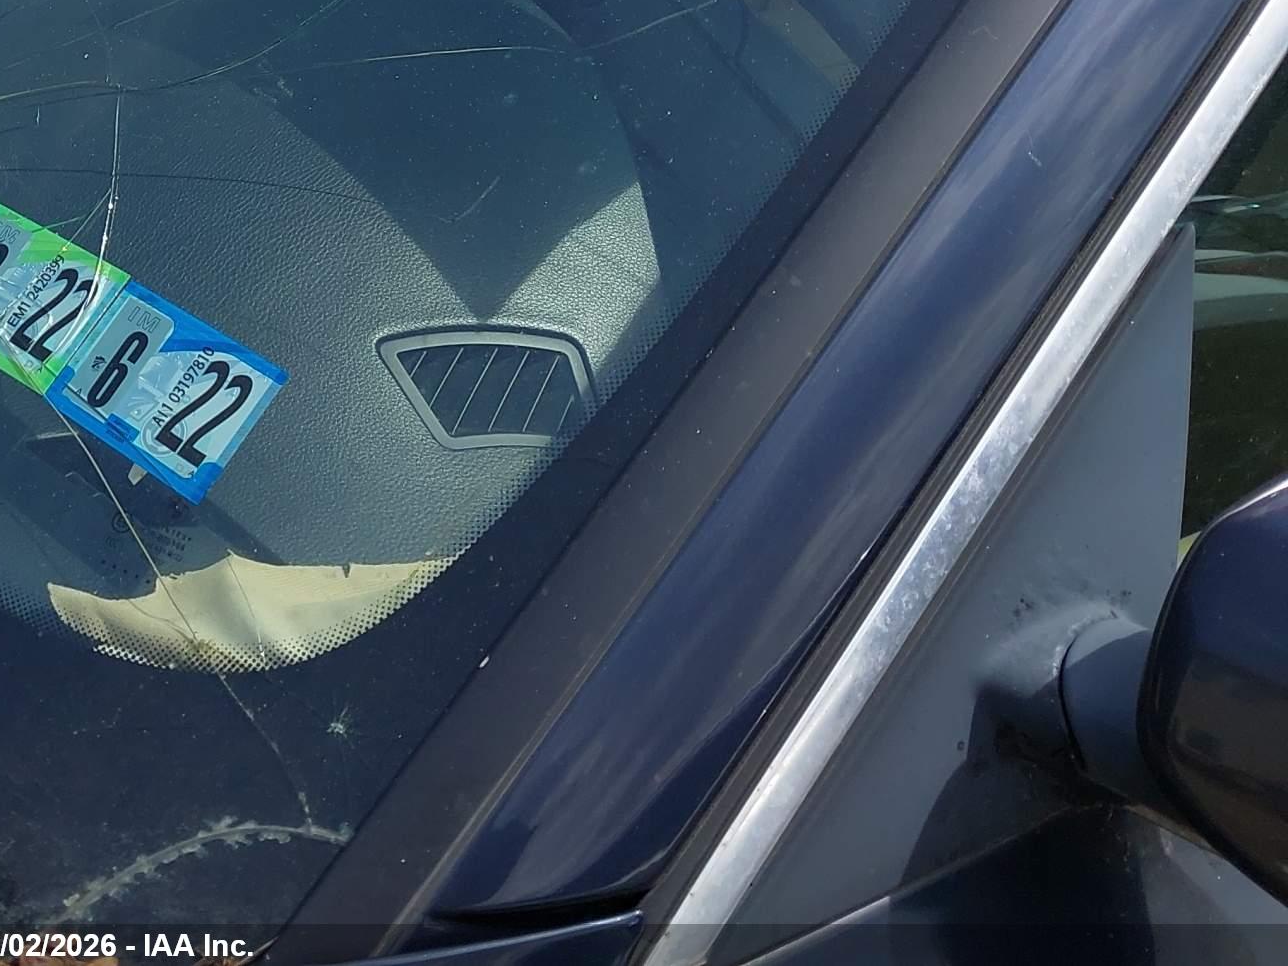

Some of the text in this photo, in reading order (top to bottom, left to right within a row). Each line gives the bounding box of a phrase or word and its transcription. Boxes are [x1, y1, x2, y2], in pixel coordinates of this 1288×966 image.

[9, 268, 99, 363] 22
[87, 330, 149, 408] 6
[167, 345, 216, 404] 03197810
[155, 359, 254, 468] 22
